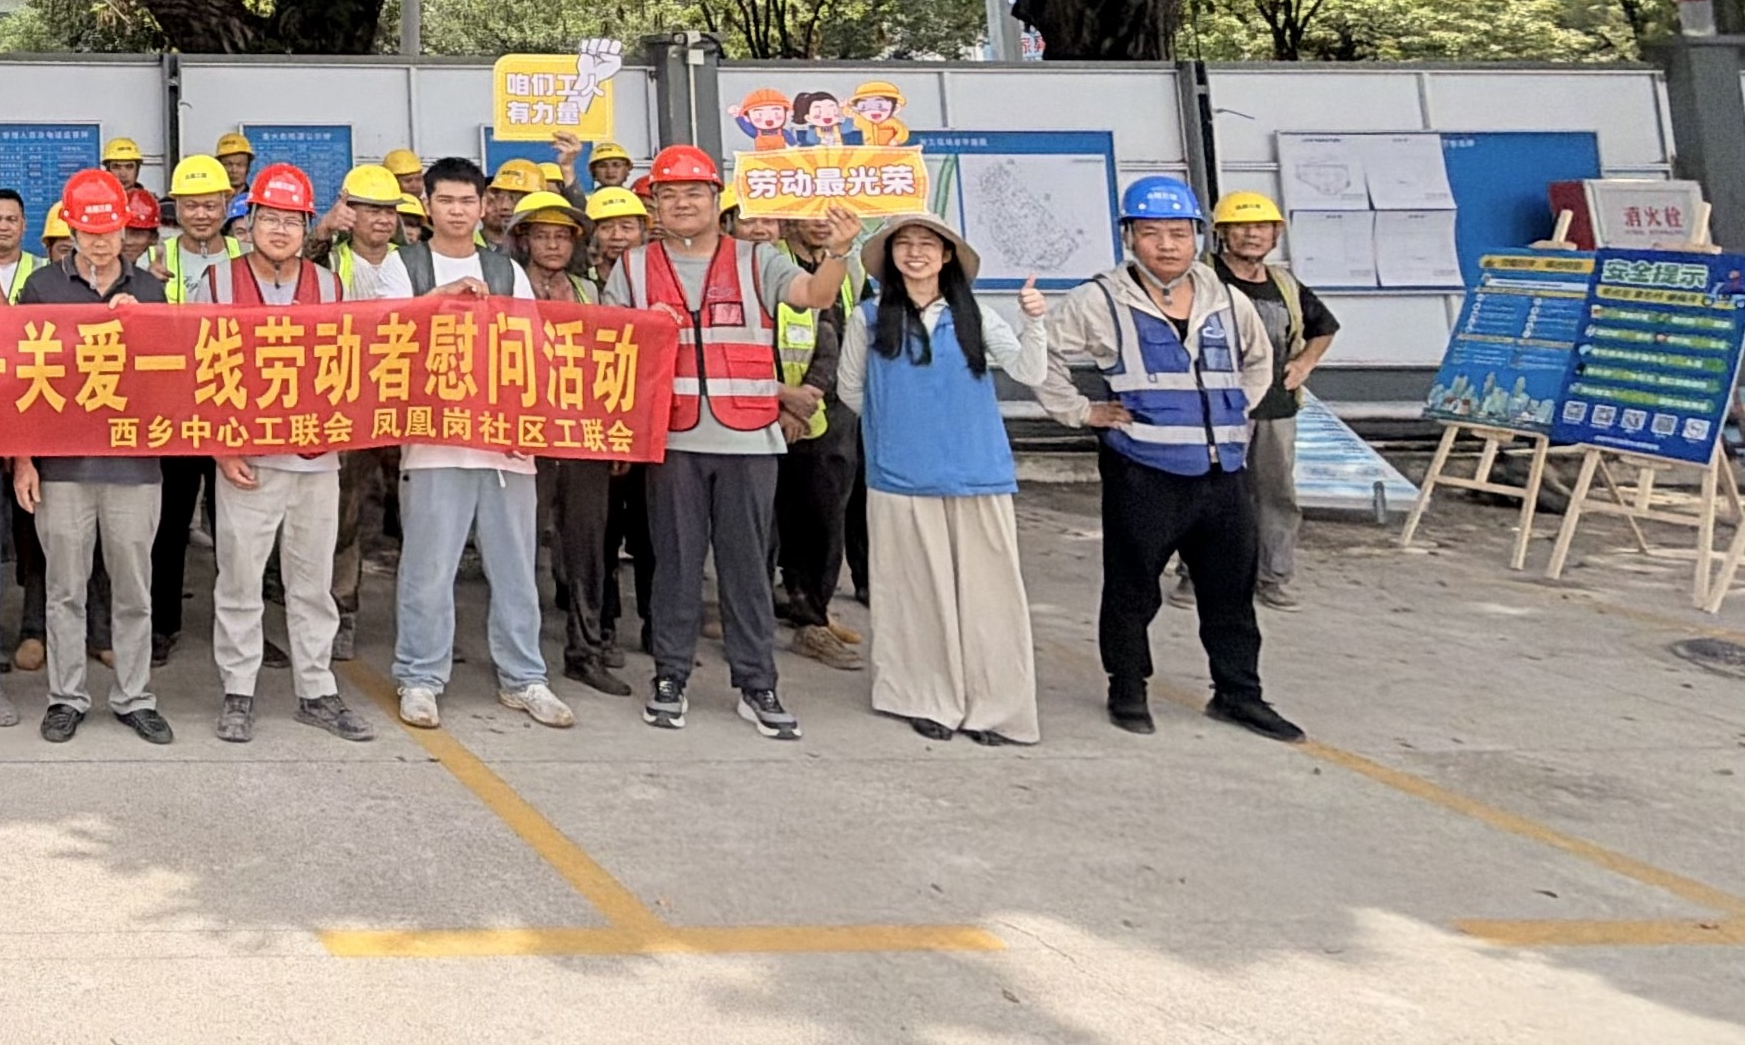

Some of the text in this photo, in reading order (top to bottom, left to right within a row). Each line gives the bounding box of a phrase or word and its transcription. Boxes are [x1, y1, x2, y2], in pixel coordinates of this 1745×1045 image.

[506, 73, 605, 96] 咱们工人
[506, 101, 580, 125] 有力量
[745, 164, 915, 199] 劳动最光荣
[1624, 206, 1683, 228] 消火栓
[1604, 259, 1707, 288] 安全提示
[109, 406, 634, 454] 西乡中心工联会 凤凰岗社区工联会
